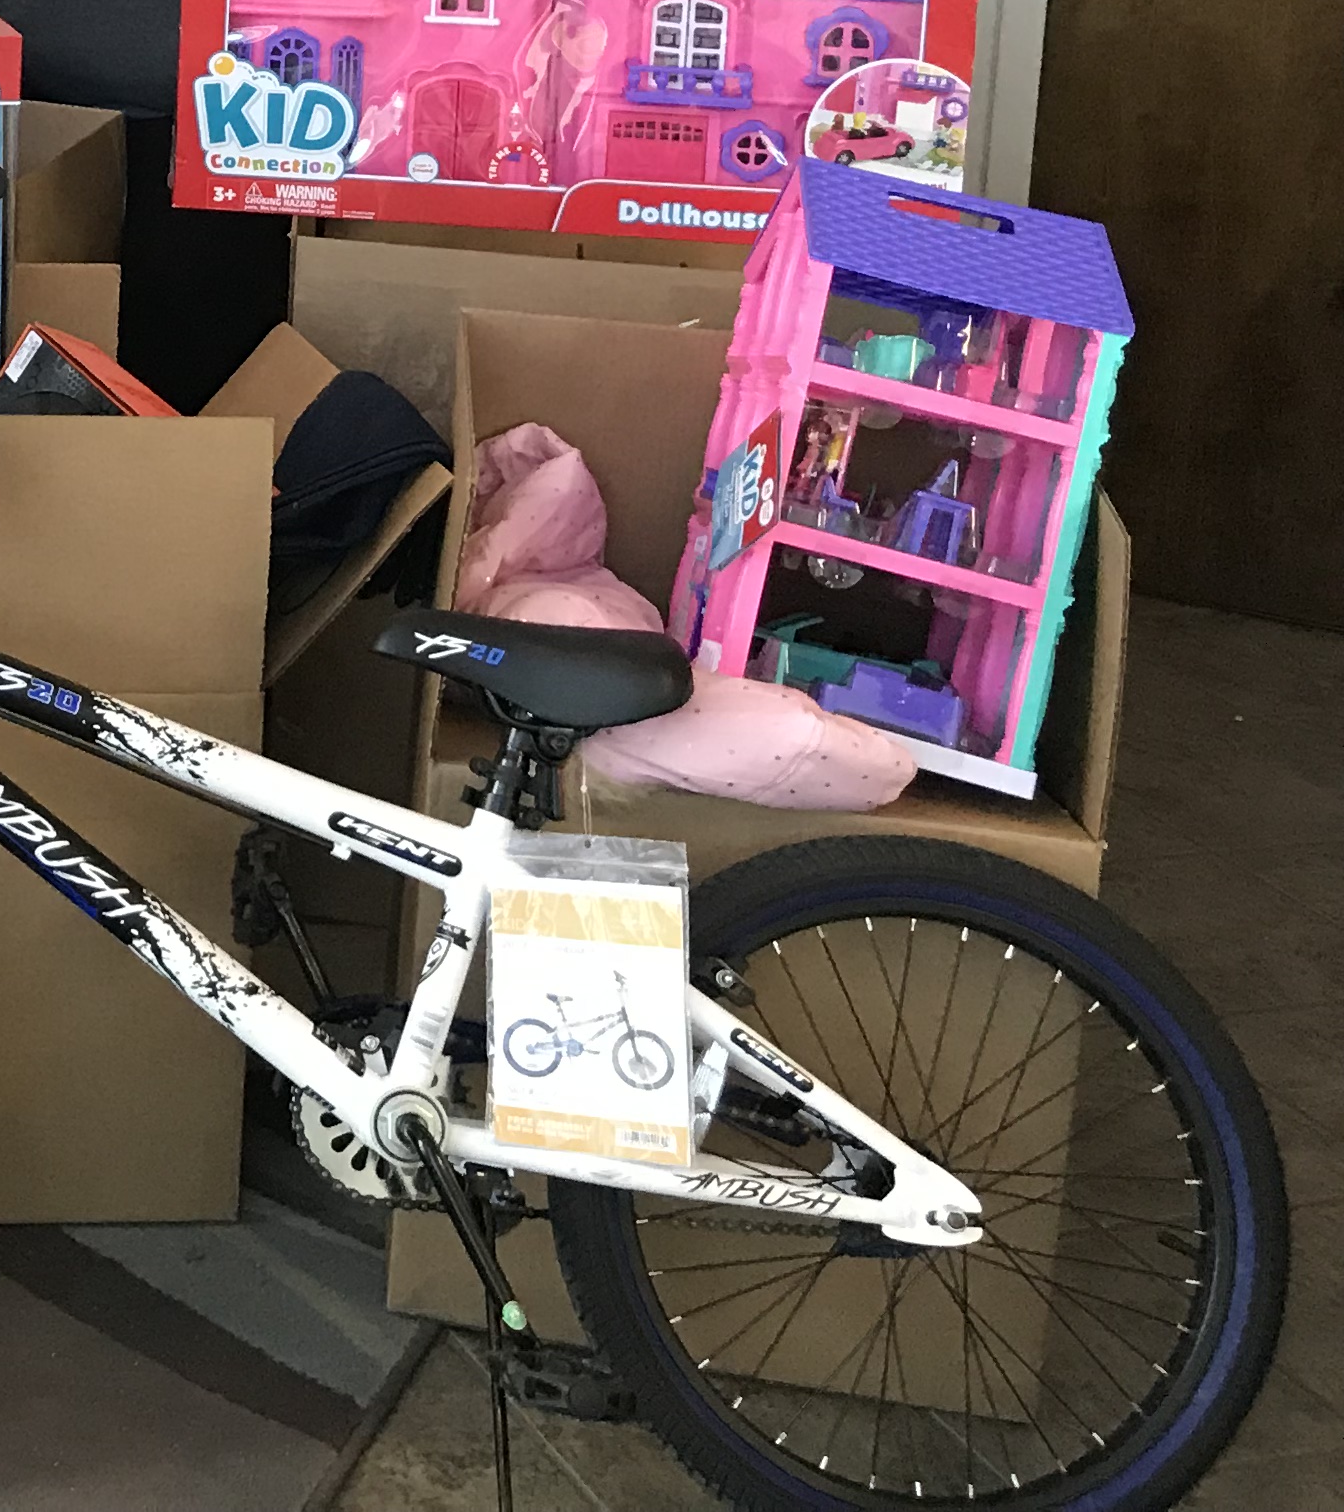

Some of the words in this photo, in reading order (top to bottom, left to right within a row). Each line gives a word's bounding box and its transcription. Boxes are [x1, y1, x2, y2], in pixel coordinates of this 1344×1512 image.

[203, 82, 346, 150] KID
[211, 154, 336, 174] Connection
[213, 187, 236, 201] 3+
[245, 196, 281, 206] CHOKING
[275, 184, 337, 201] WARNING:
[336, 815, 459, 872] KENT
[736, 1031, 811, 1088] KENT
[671, 1169, 842, 1215] AMBUSH
